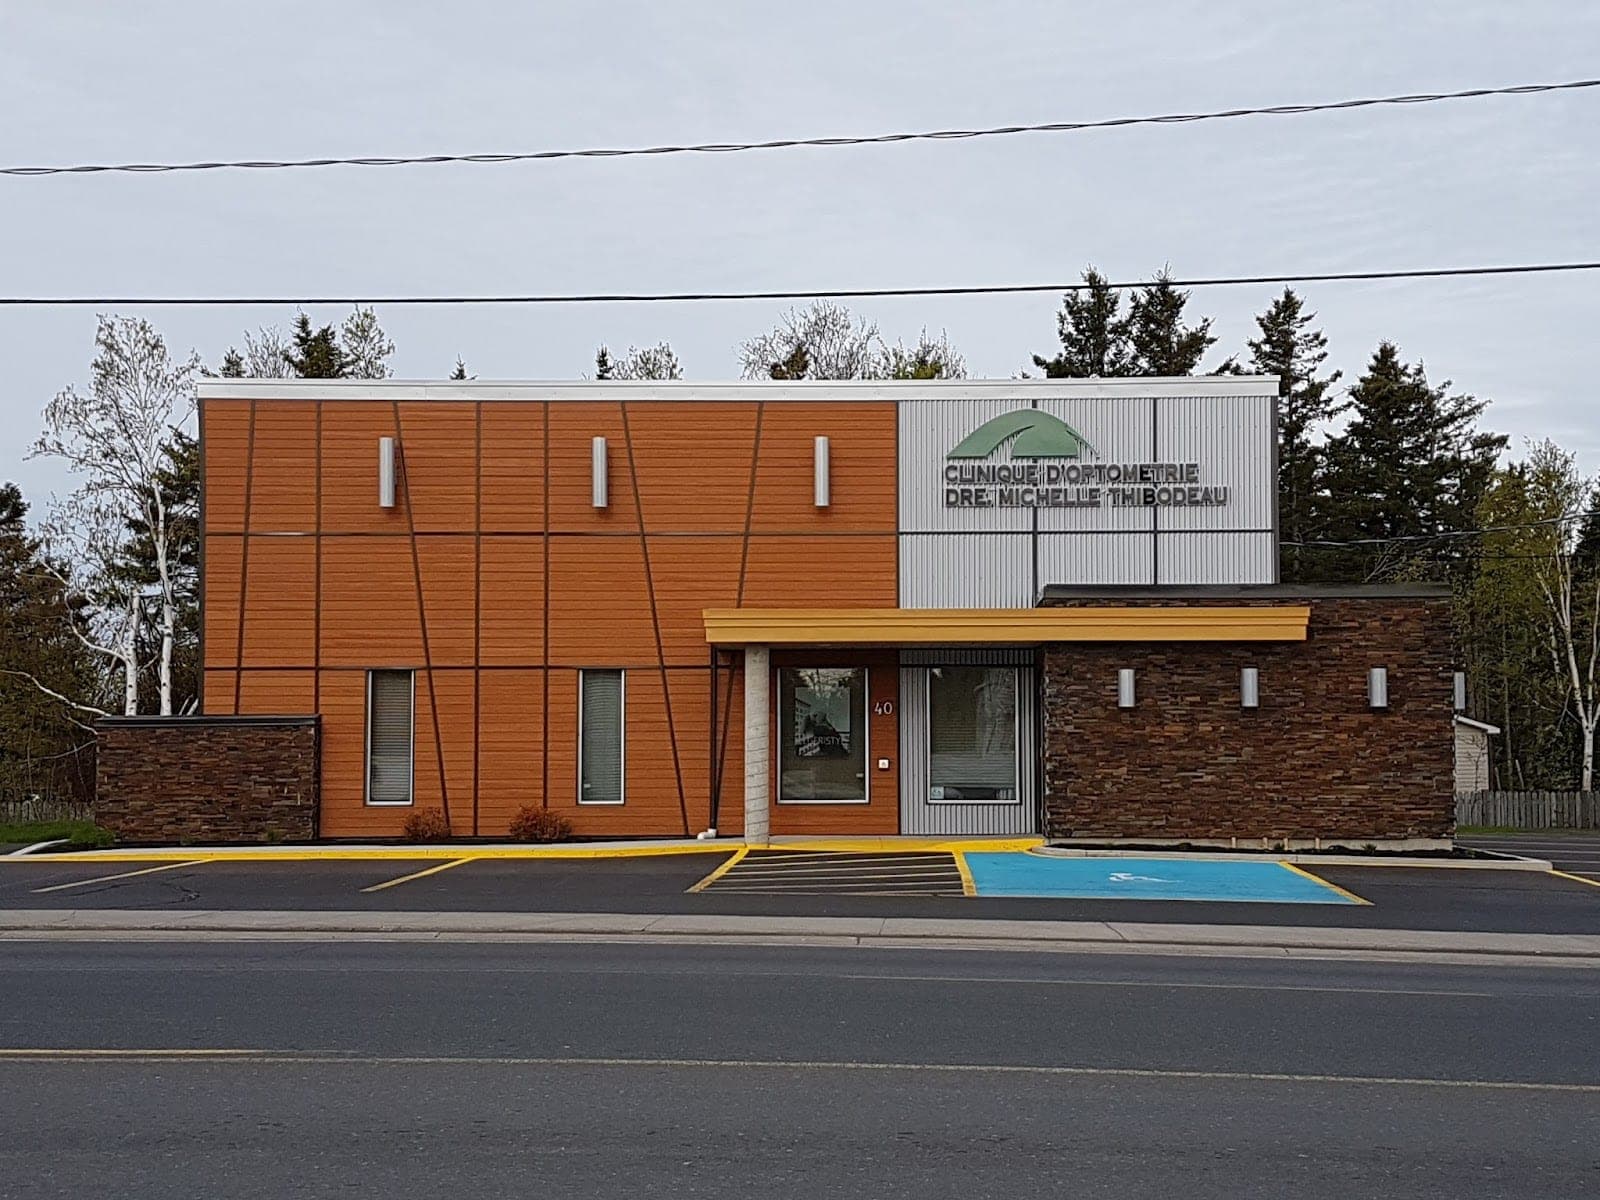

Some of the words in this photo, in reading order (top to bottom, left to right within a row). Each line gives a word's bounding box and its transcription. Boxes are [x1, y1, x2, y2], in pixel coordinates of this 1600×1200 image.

[944, 464, 1038, 483] CLINIQUE
[1046, 464, 1198, 483] D'OPTOMETRIE
[998, 487, 1100, 506] MICHELLE
[1108, 487, 1228, 505] THIBODEAU
[874, 702, 893, 715] 40
